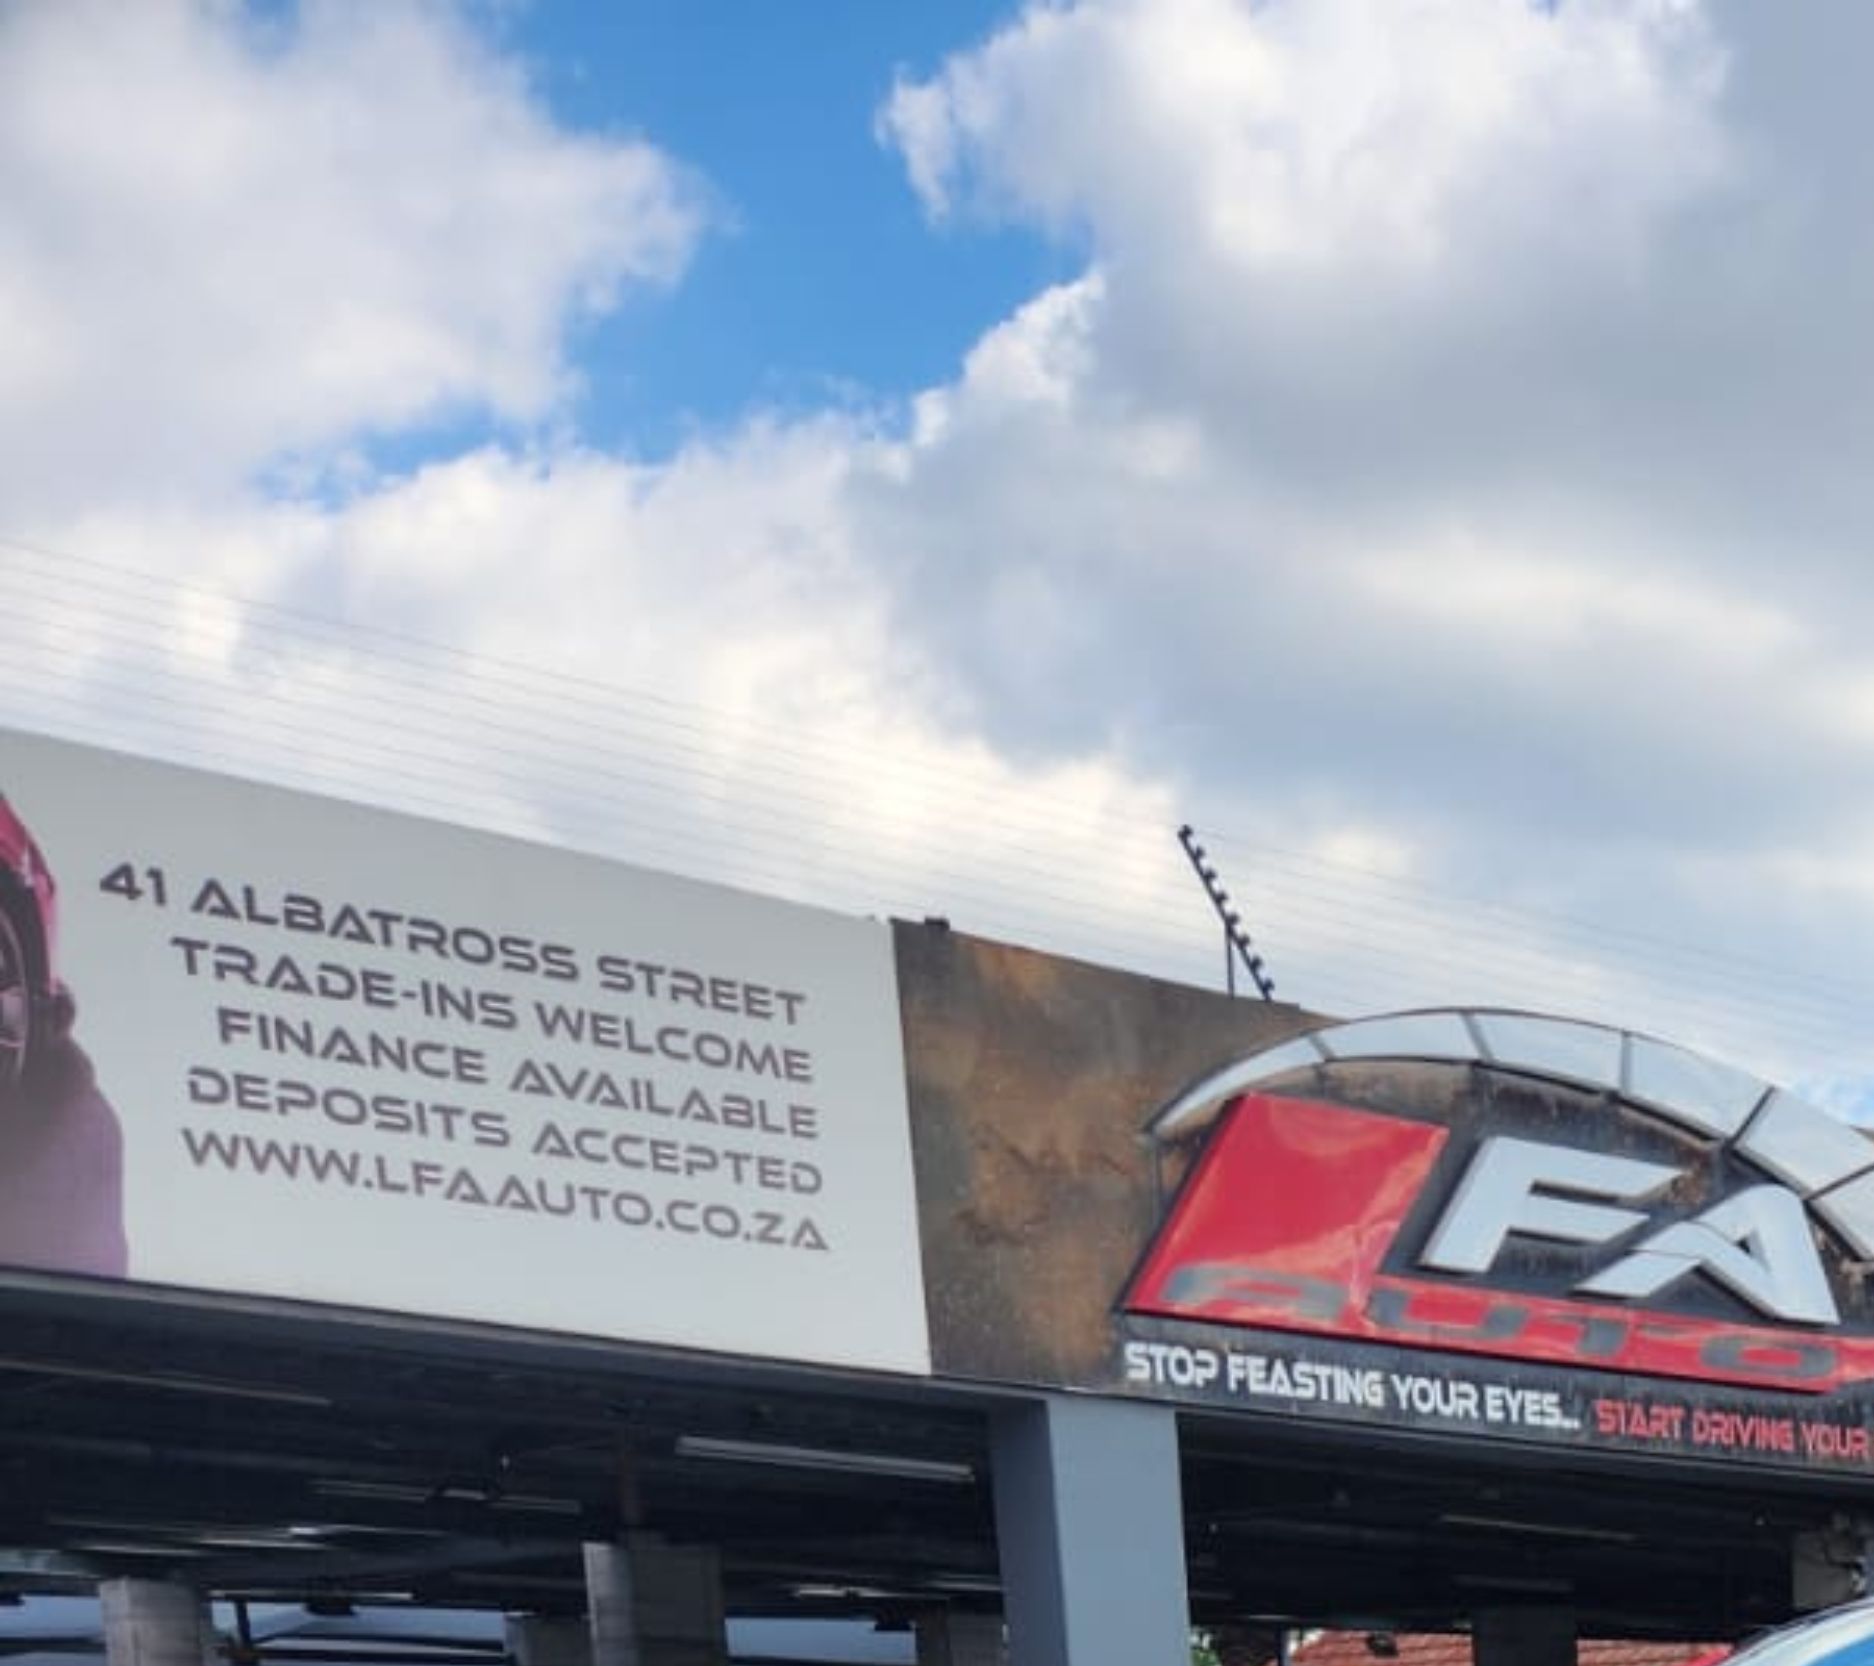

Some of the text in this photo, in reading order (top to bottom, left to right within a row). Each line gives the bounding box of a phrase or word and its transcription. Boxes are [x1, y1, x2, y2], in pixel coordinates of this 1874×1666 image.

[98, 862, 807, 1026] 41 ALBATROSS STREET
[170, 935, 814, 1084] TRADE-INS WELCOME
[217, 1006, 819, 1140] FINANCE AVAILABLE
[181, 1126, 831, 1252] WWW.LFAAUTO.CO.ZA
[187, 1065, 823, 1195] DEPOSITS ACCEPTED
[1160, 1261, 1845, 1380] AUTO
[1122, 1340, 1219, 1388] STOP
[1226, 1352, 1385, 1408] FEASTING
[1391, 1372, 1481, 1419] YOUR
[1485, 1385, 1582, 1430] EYES...
[1594, 1400, 1687, 1442] START
[1692, 1410, 1796, 1454] DRIVING
